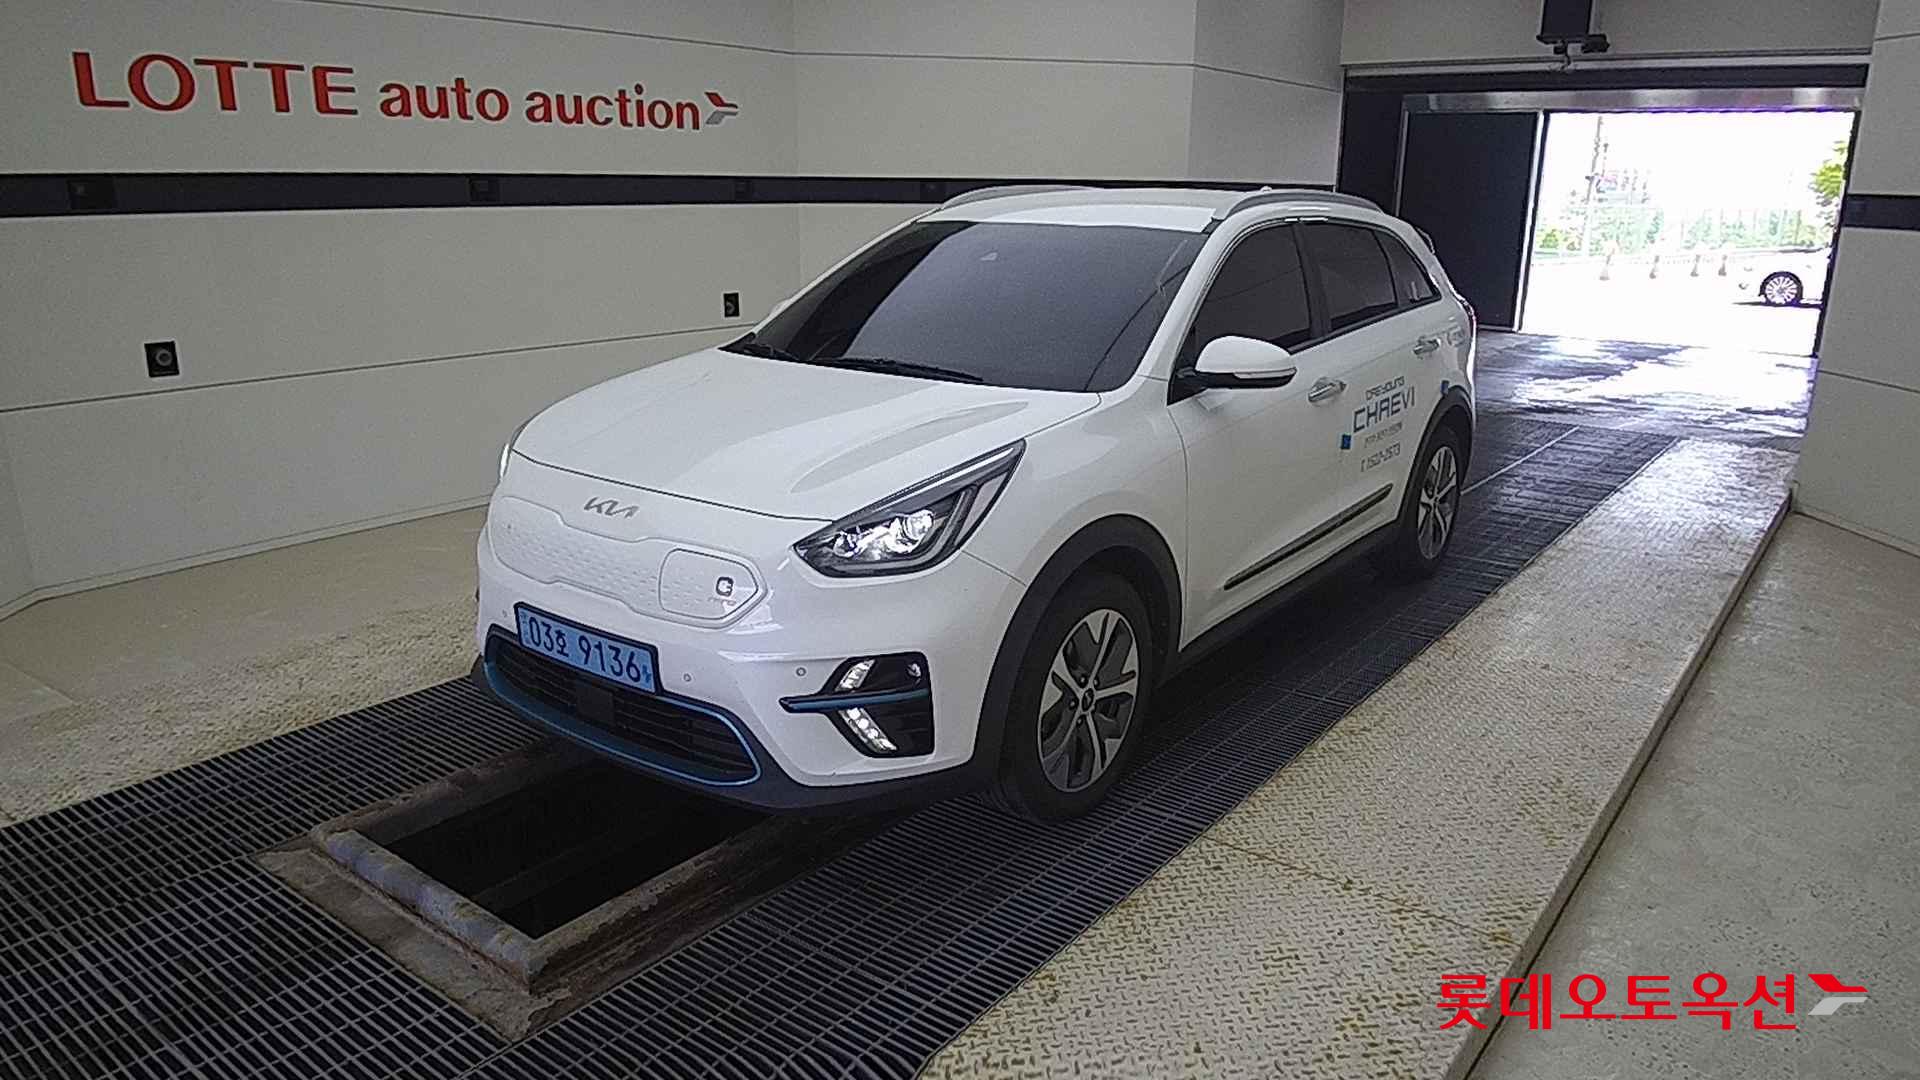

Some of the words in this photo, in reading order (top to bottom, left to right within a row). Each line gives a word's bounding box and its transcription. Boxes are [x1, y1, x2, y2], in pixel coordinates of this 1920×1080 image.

[72, 52, 358, 115] LOTTE
[379, 77, 510, 123] auto
[525, 84, 702, 131] auction
[1353, 386, 1415, 433] CHAEVI
[528, 616, 569, 658] 03호
[578, 635, 641, 683] 9136
